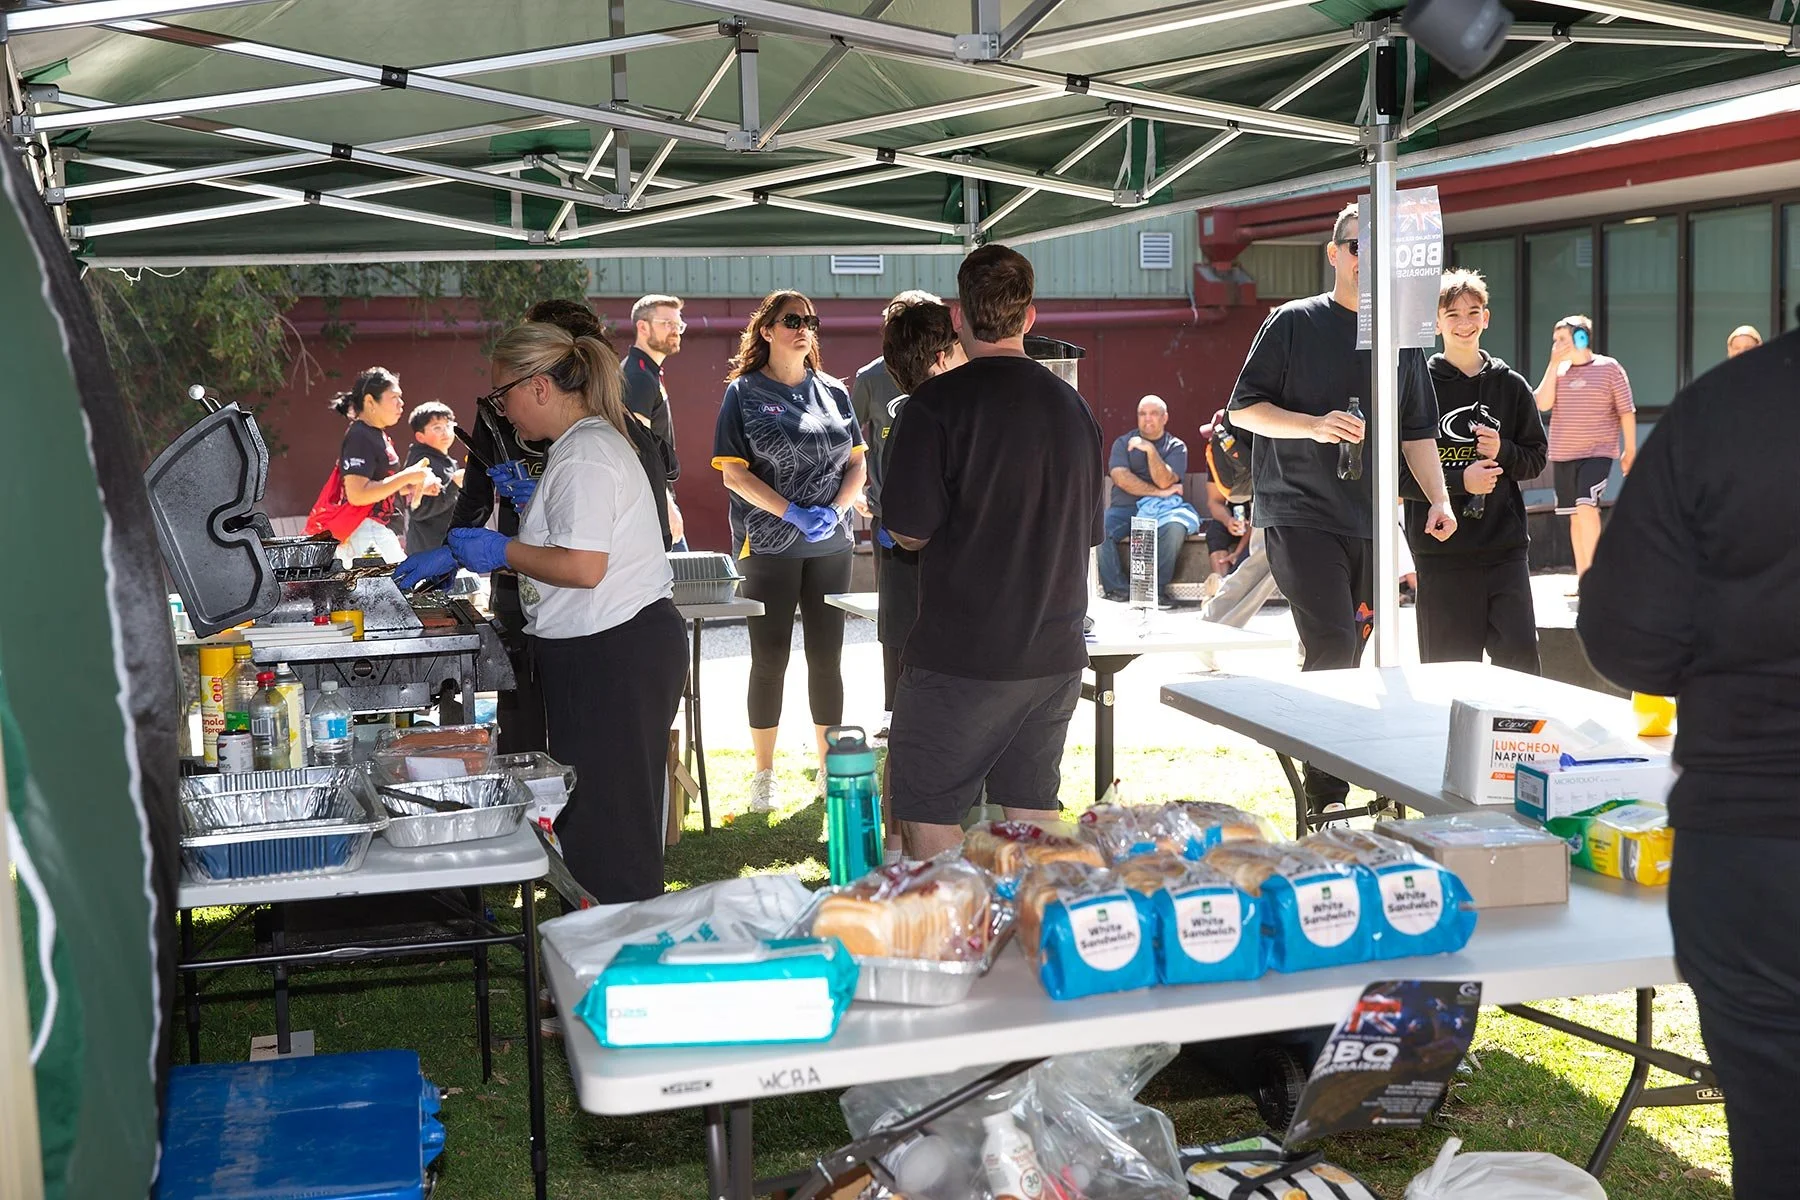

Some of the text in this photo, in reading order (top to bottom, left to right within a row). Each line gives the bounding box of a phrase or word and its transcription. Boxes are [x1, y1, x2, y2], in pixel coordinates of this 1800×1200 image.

[763, 404, 785, 413] AFL
[203, 717, 225, 726] nola
[1494, 740, 1560, 755] LUNCHEON
[1494, 751, 1536, 763] NAPKIN
[1394, 891, 1427, 901] White
[1312, 902, 1344, 913] White
[1387, 900, 1439, 914] Sandwich
[1191, 917, 1224, 928] White
[1303, 910, 1356, 925] Sandwich
[1088, 923, 1122, 937] White
[1182, 927, 1237, 939] Sandwich
[1080, 931, 1136, 950] Sandwich
